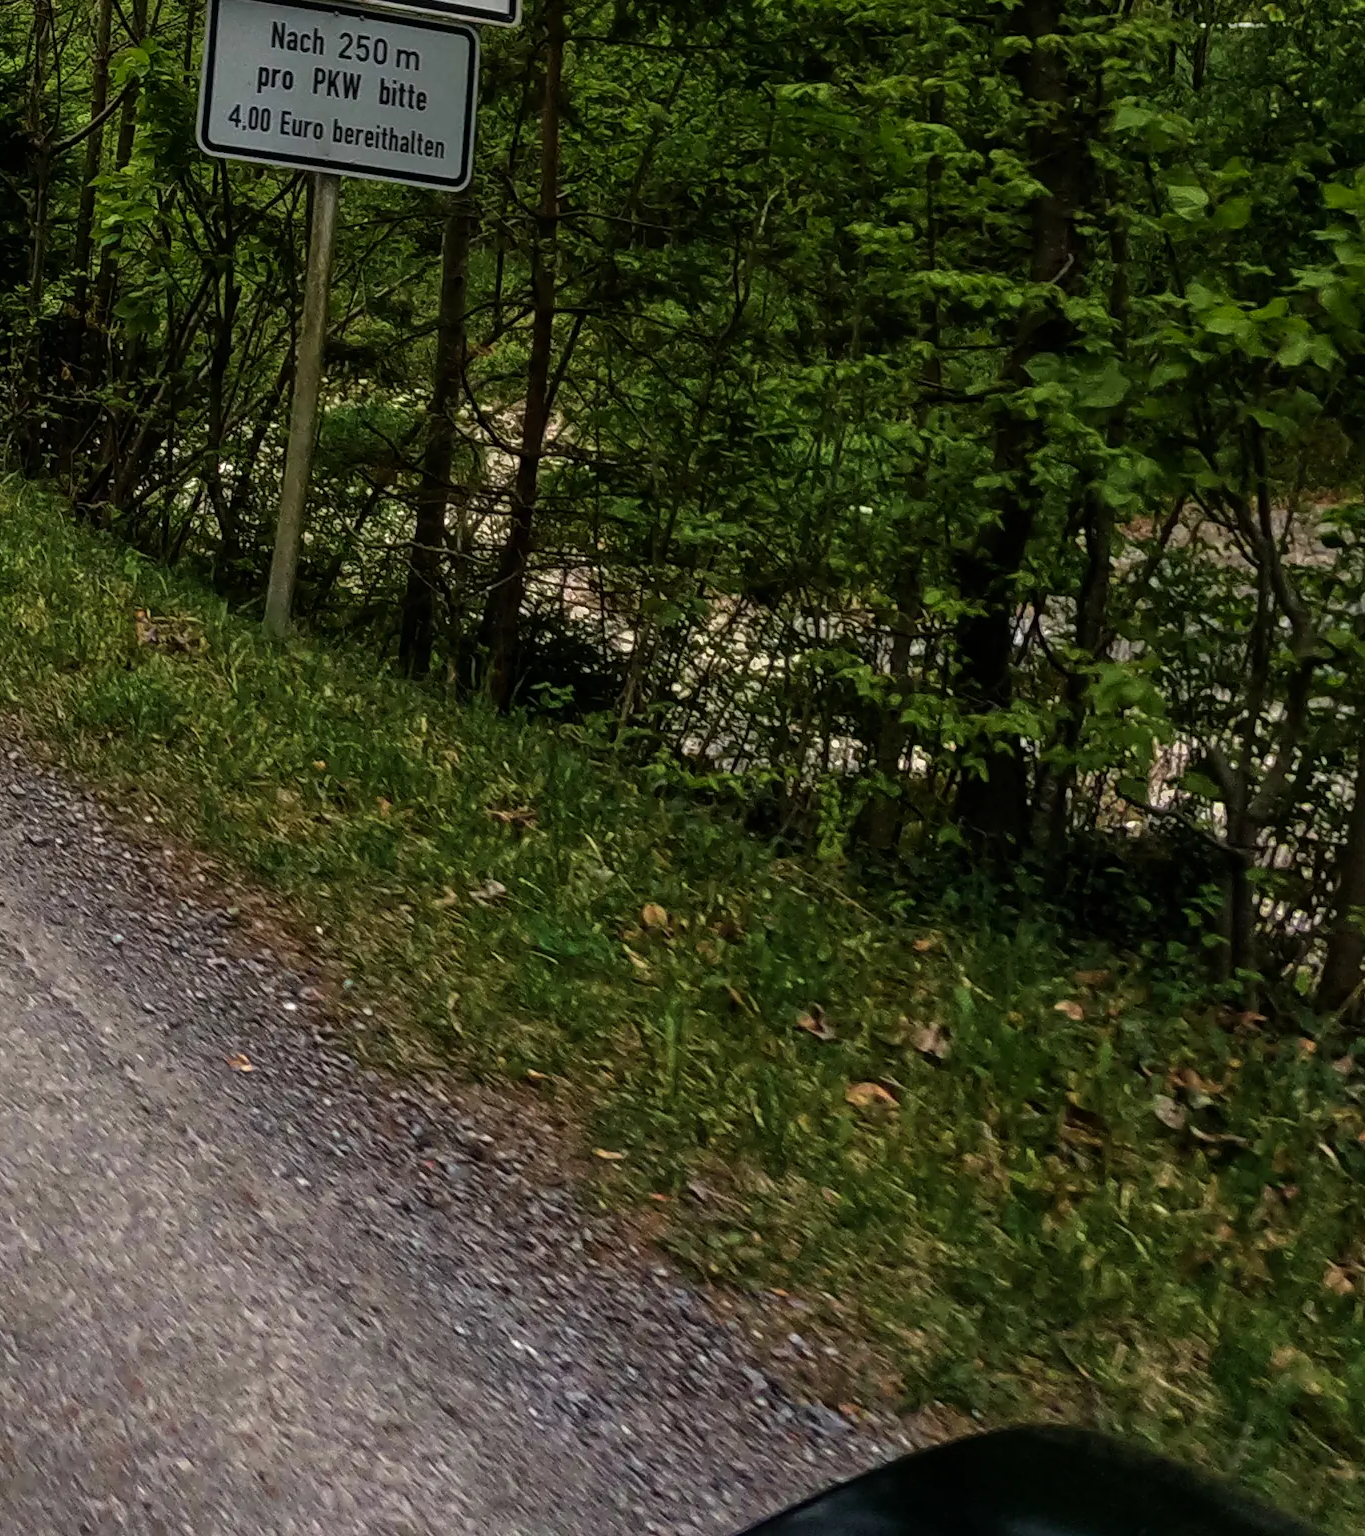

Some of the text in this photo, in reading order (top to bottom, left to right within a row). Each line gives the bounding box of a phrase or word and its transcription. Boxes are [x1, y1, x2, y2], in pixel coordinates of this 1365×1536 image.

[271, 21, 420, 71] Nach 250 m
[256, 66, 427, 111] pro PKW bitte
[280, 111, 324, 140] Euro
[332, 119, 445, 159] bereithalten
